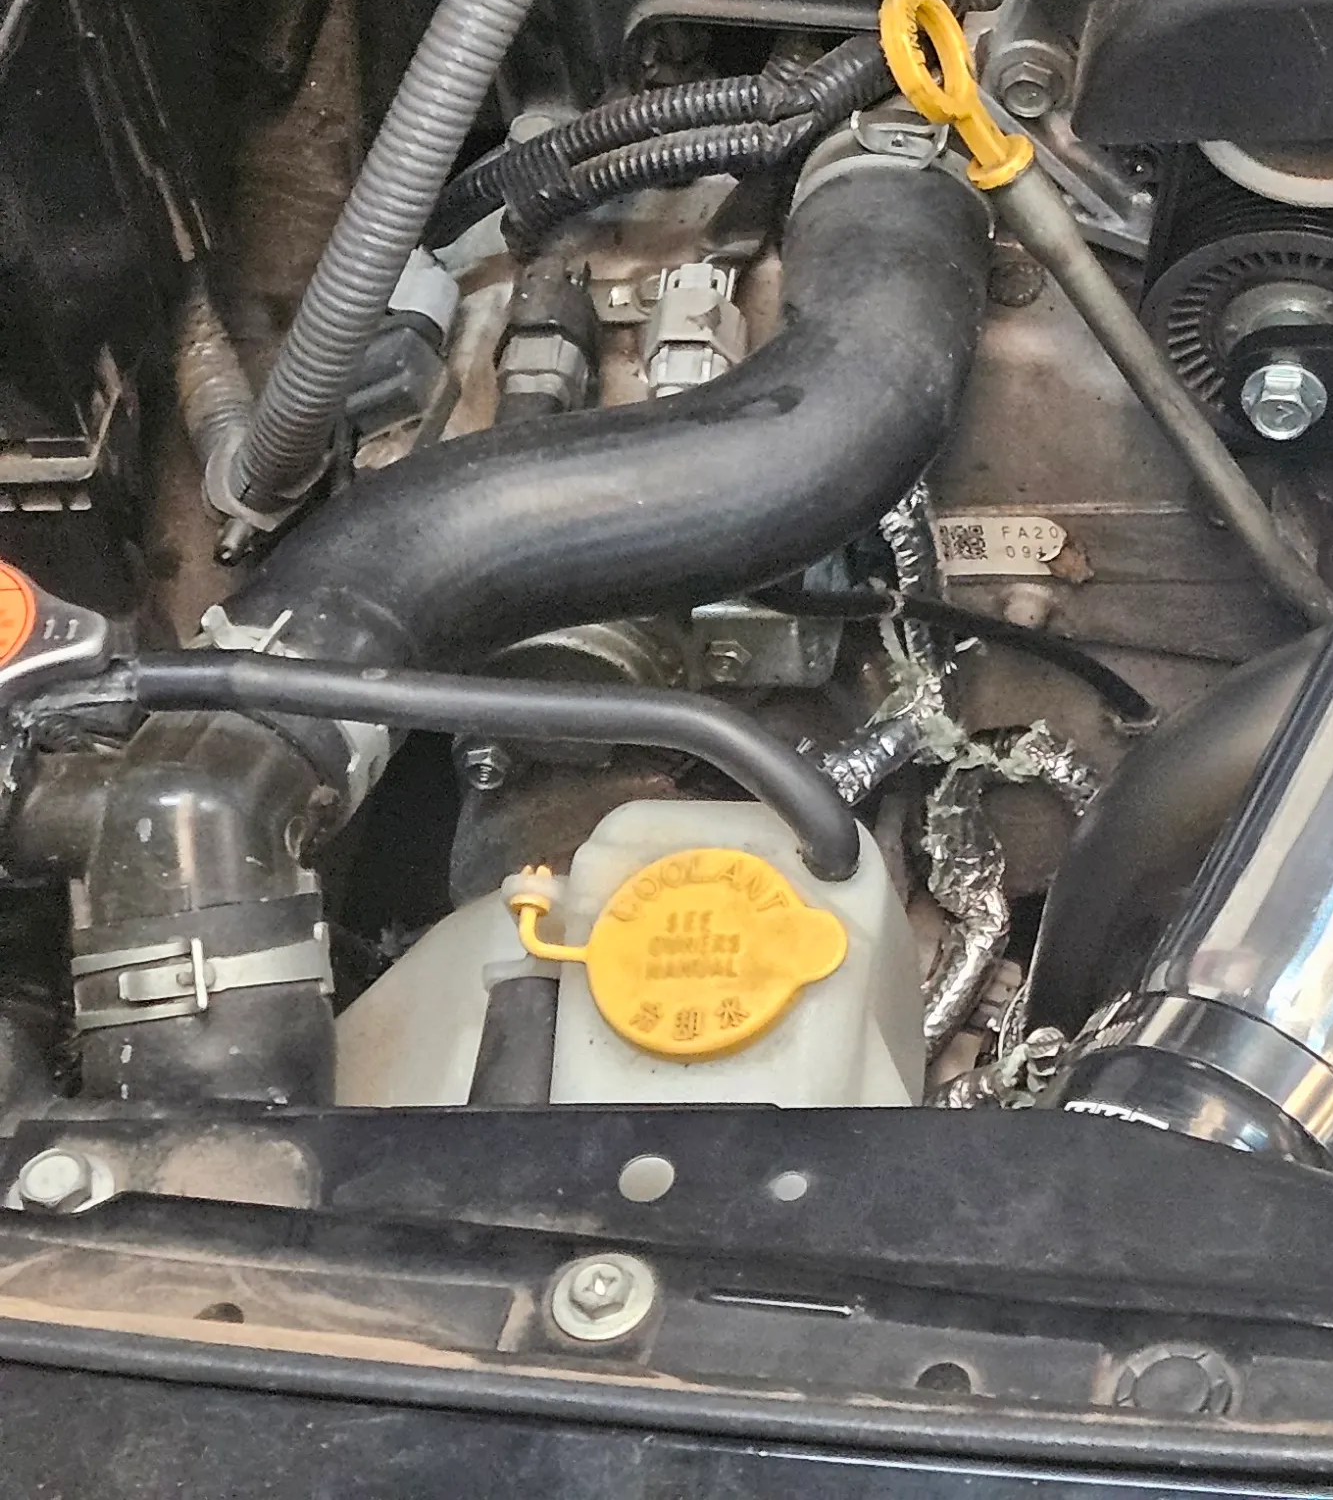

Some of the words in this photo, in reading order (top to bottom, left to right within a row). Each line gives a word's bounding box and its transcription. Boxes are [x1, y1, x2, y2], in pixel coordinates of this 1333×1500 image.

[1001, 525, 1060, 540] FA20
[43, 618, 79, 641] 1.1
[609, 855, 791, 922] COOLANT
